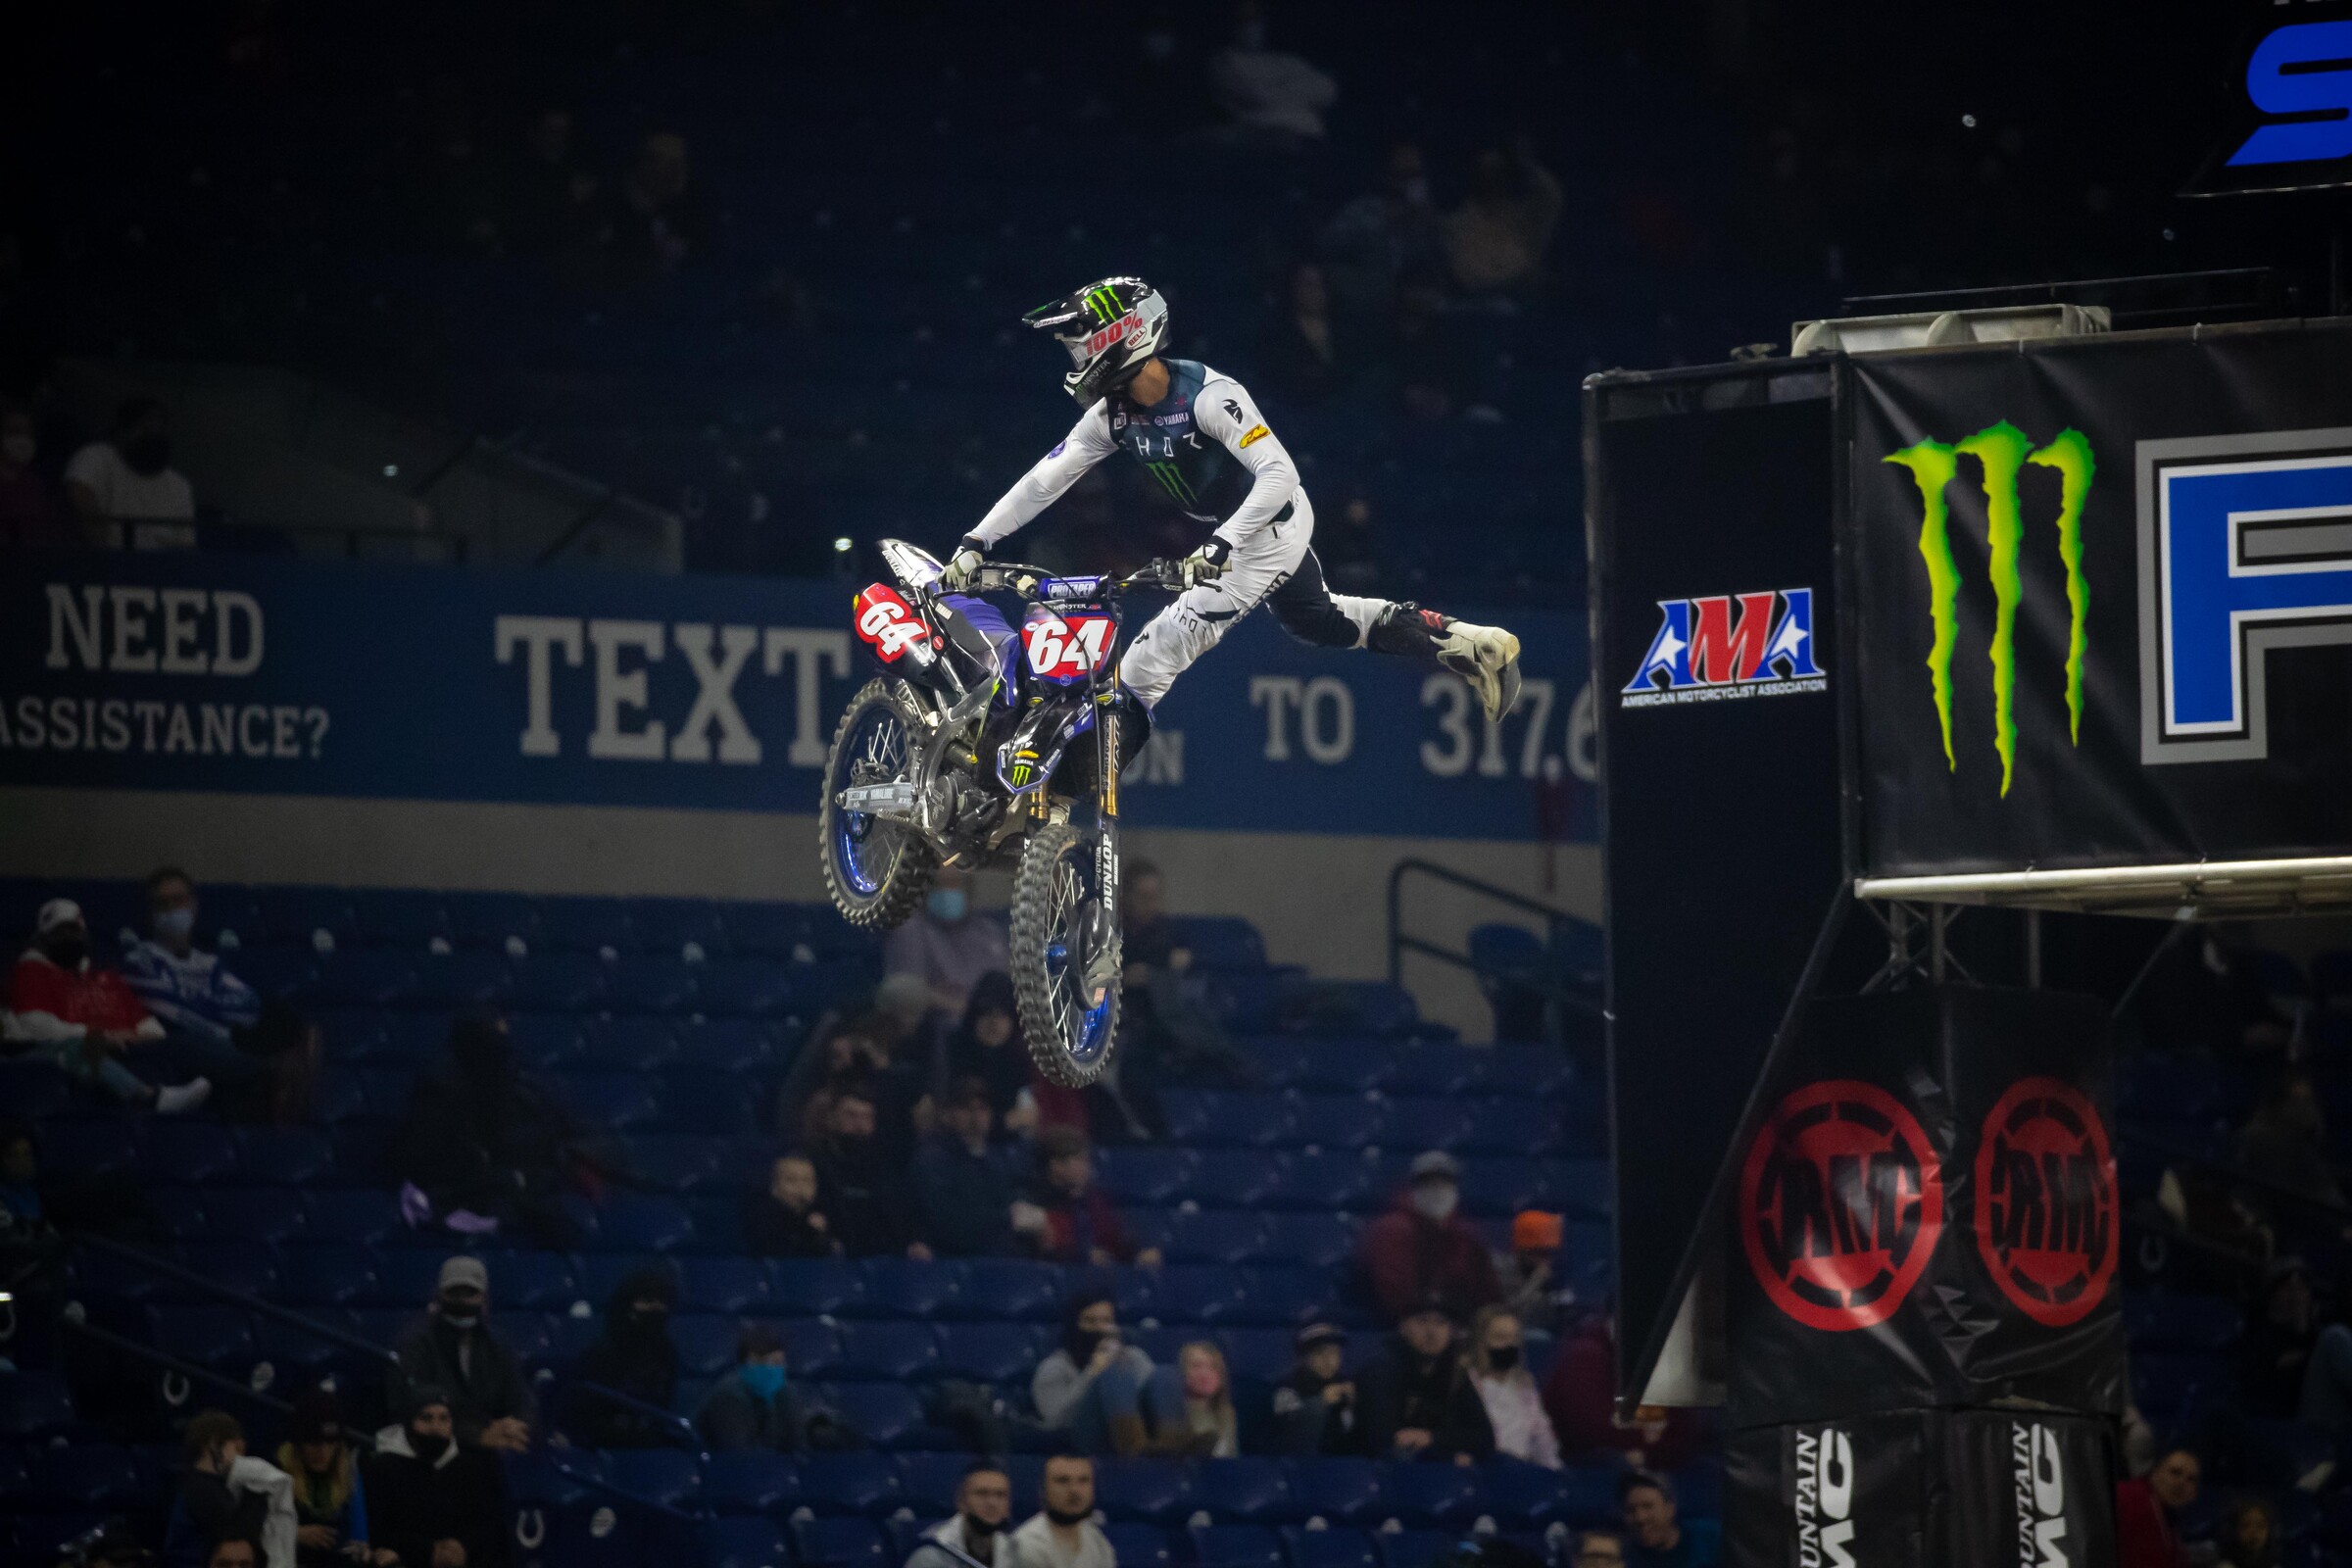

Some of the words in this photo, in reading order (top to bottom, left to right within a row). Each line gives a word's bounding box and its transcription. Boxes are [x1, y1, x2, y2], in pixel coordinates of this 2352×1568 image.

[1085, 314, 1143, 355] 100%
[1128, 330, 1145, 347] BELL
[1164, 412, 1190, 425] YAMAHA
[45, 583, 265, 676] NEED
[860, 602, 925, 656] 64
[1028, 620, 1102, 673] 64
[1621, 588, 1826, 694] AMA
[494, 613, 852, 767] TEXT
[1621, 692, 1676, 708] AMERICAN
[1678, 685, 1755, 703] MOTORCYCLIST
[1757, 679, 1827, 697] ASSOCIATION
[1250, 675, 1354, 762] TO
[1102, 833, 1113, 911] DUNLOP
